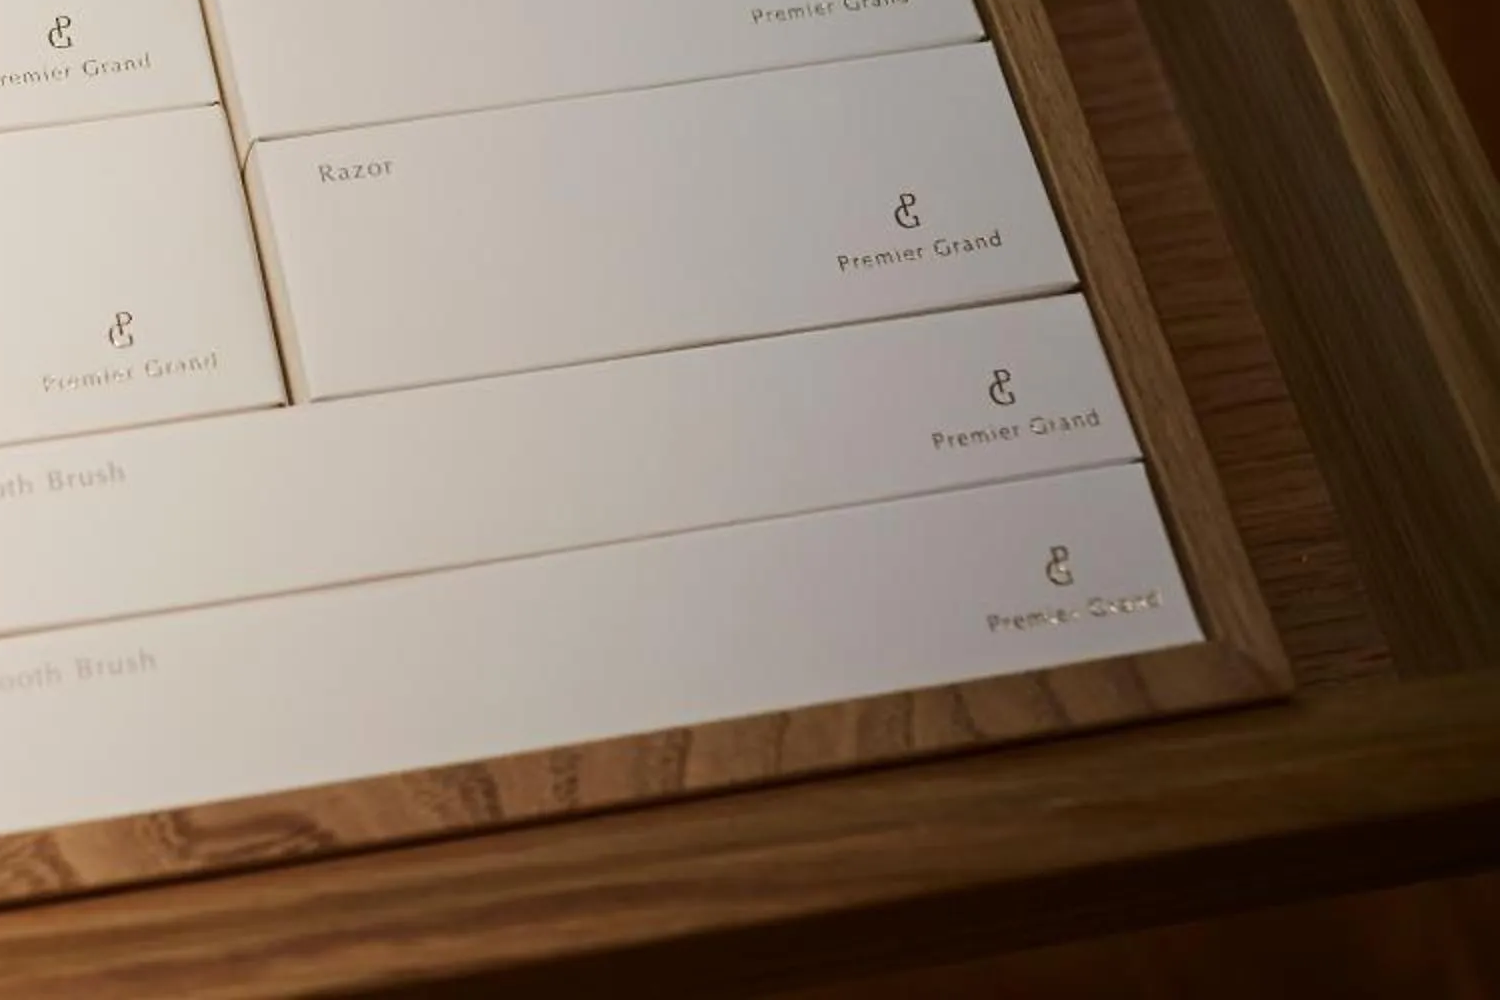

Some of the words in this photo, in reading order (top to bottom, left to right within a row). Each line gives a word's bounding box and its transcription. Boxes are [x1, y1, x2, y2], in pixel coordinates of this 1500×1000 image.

[751, 1, 836, 25] Premier
[82, 52, 153, 78] Grand
[316, 159, 395, 184] Razor
[837, 246, 925, 273] Premier
[933, 229, 1004, 258] Grand
[42, 367, 135, 394] Premier
[144, 352, 219, 380] Grand
[931, 423, 1021, 451] Premier
[1029, 407, 1102, 436] Grand
[46, 459, 129, 492] Brush
[985, 607, 1080, 633] Premier
[1087, 589, 1163, 618] Grand
[74, 646, 159, 681] Brush
